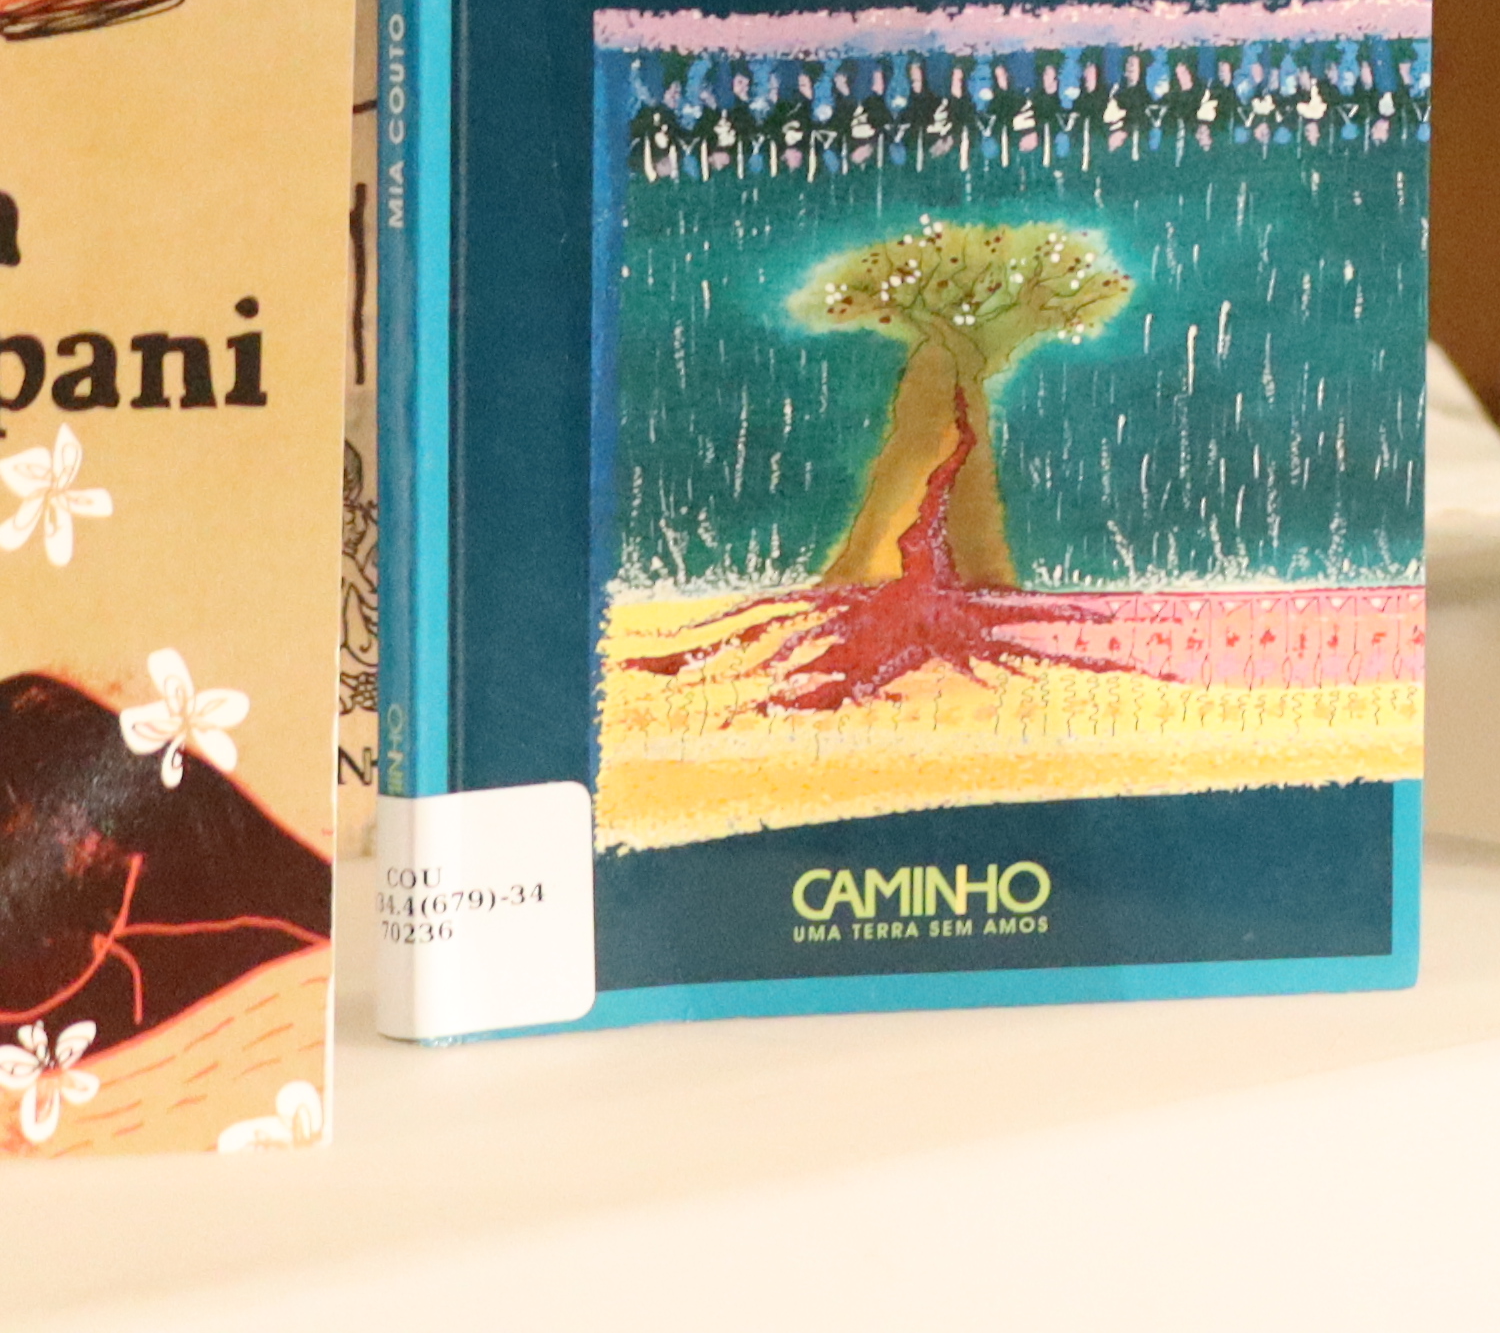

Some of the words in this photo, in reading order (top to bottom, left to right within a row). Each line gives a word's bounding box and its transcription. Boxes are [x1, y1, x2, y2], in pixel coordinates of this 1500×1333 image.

[388, 13, 406, 145] COUTO
[388, 160, 405, 229] MIA
[386, 865, 442, 890] COU
[792, 860, 1051, 921] CAMINHO
[381, 919, 454, 945] 70236
[793, 924, 842, 943] UMA
[852, 921, 920, 941] TERRA
[928, 918, 973, 938] SEM
[982, 915, 1050, 935] AMOS
